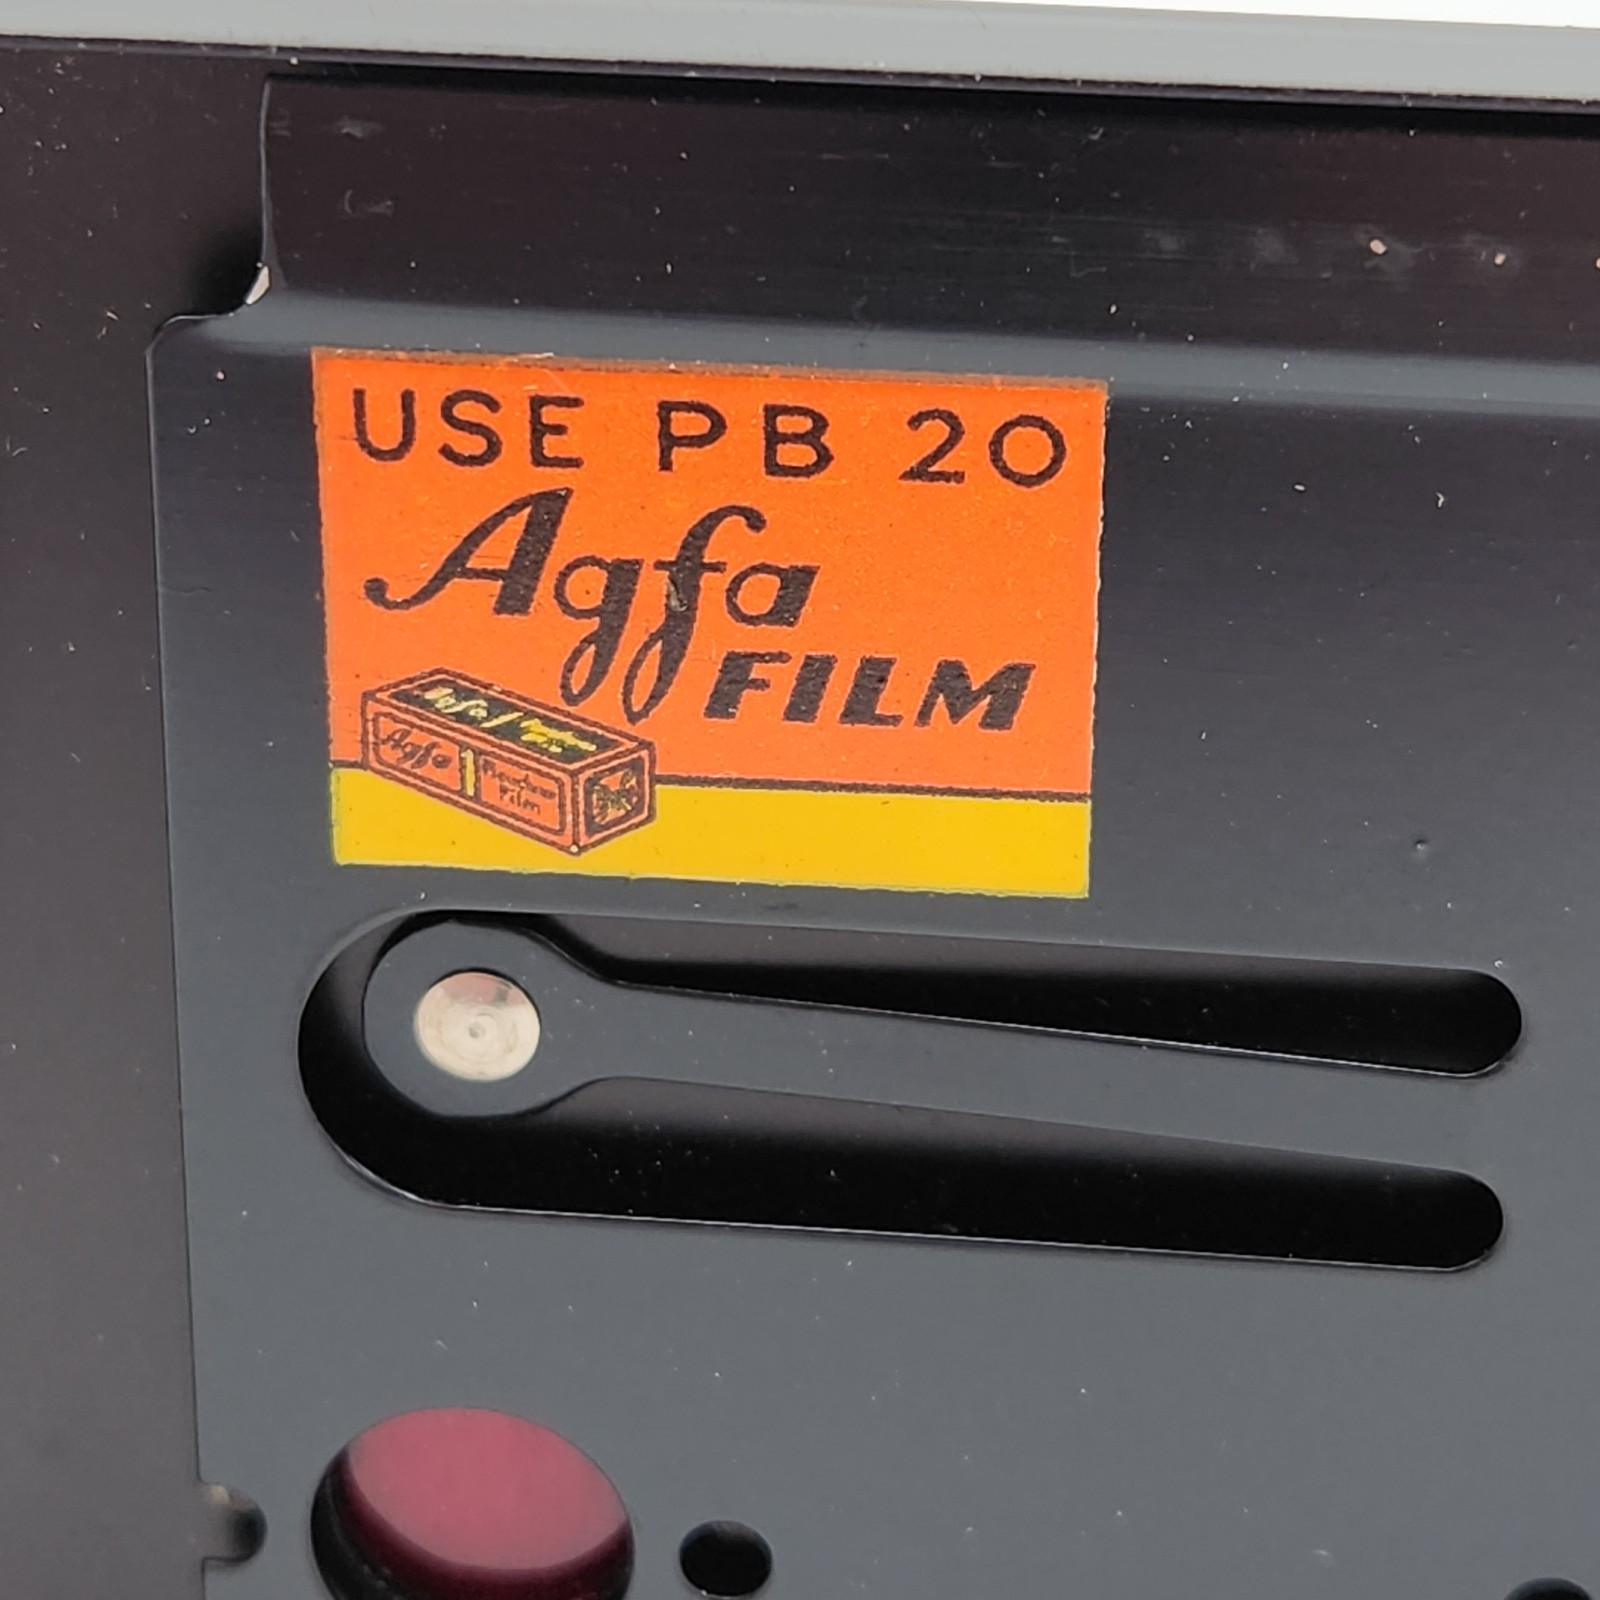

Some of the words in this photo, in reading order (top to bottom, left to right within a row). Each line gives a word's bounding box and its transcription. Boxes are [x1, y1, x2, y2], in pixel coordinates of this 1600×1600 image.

[353, 388, 584, 468] USE
[900, 408, 1067, 487] 20
[364, 487, 820, 723] Agfa
[704, 651, 1036, 730] FILM
